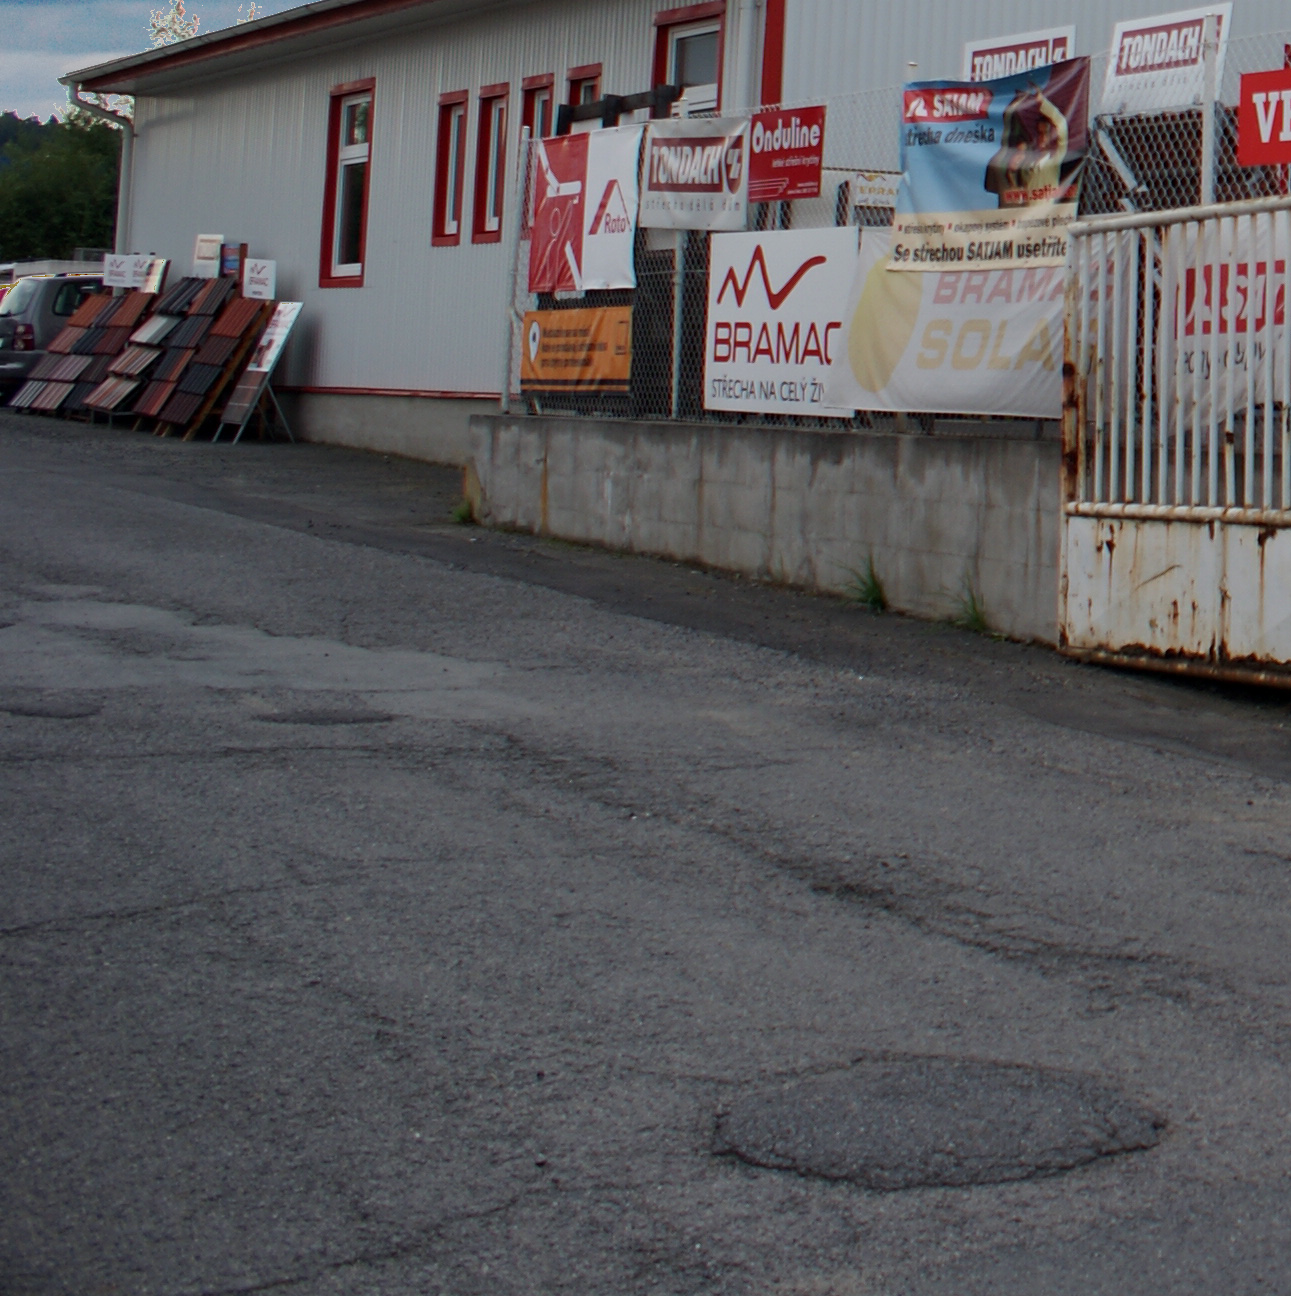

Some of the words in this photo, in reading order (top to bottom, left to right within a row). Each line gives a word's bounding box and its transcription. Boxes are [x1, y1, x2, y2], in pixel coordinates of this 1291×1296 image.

[1120, 25, 1201, 70] TONDACH
[752, 116, 821, 154] Onduline
[944, 123, 996, 144] dneška
[652, 145, 723, 184] TONDACH
[604, 213, 628, 235] Roto
[966, 239, 1014, 262] SATJAM
[713, 321, 842, 365] BRAMAC
[712, 375, 756, 400] STŘECHA
[759, 380, 777, 400] NA
[780, 377, 808, 402] CELÝ
